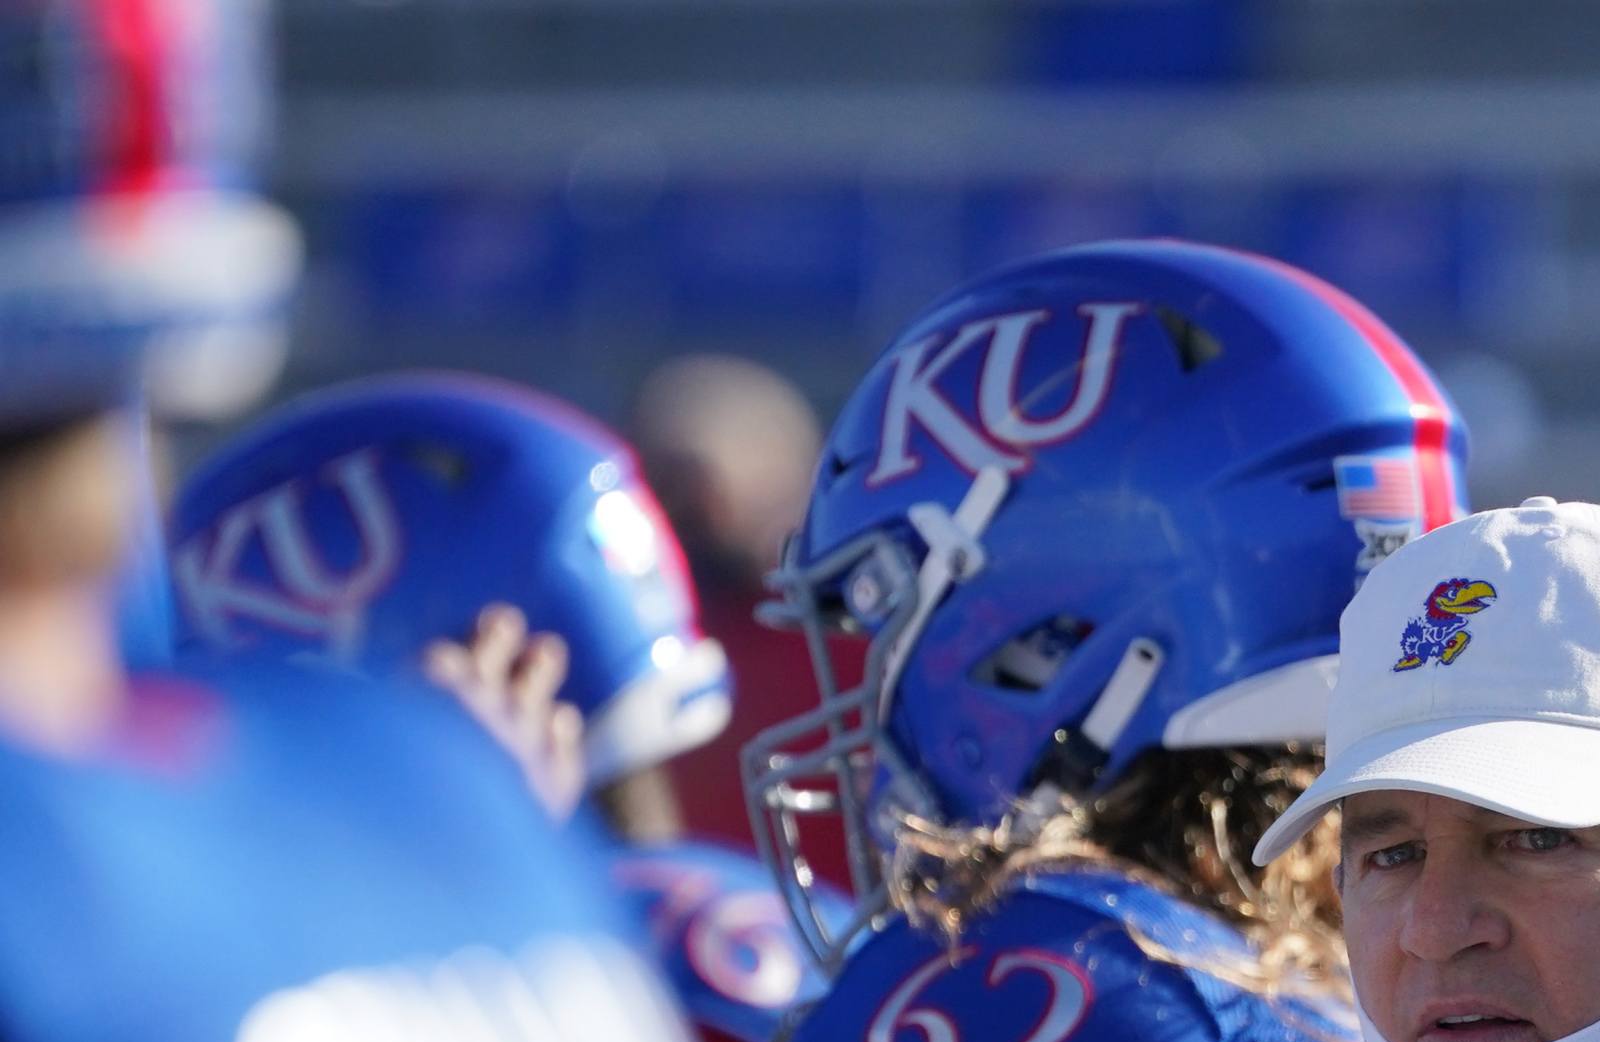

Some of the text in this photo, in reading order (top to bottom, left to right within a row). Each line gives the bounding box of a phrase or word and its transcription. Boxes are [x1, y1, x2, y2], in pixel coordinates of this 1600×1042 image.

[863, 300, 1148, 489] KU
[164, 445, 403, 662] KU
[1420, 625, 1450, 645] KU
